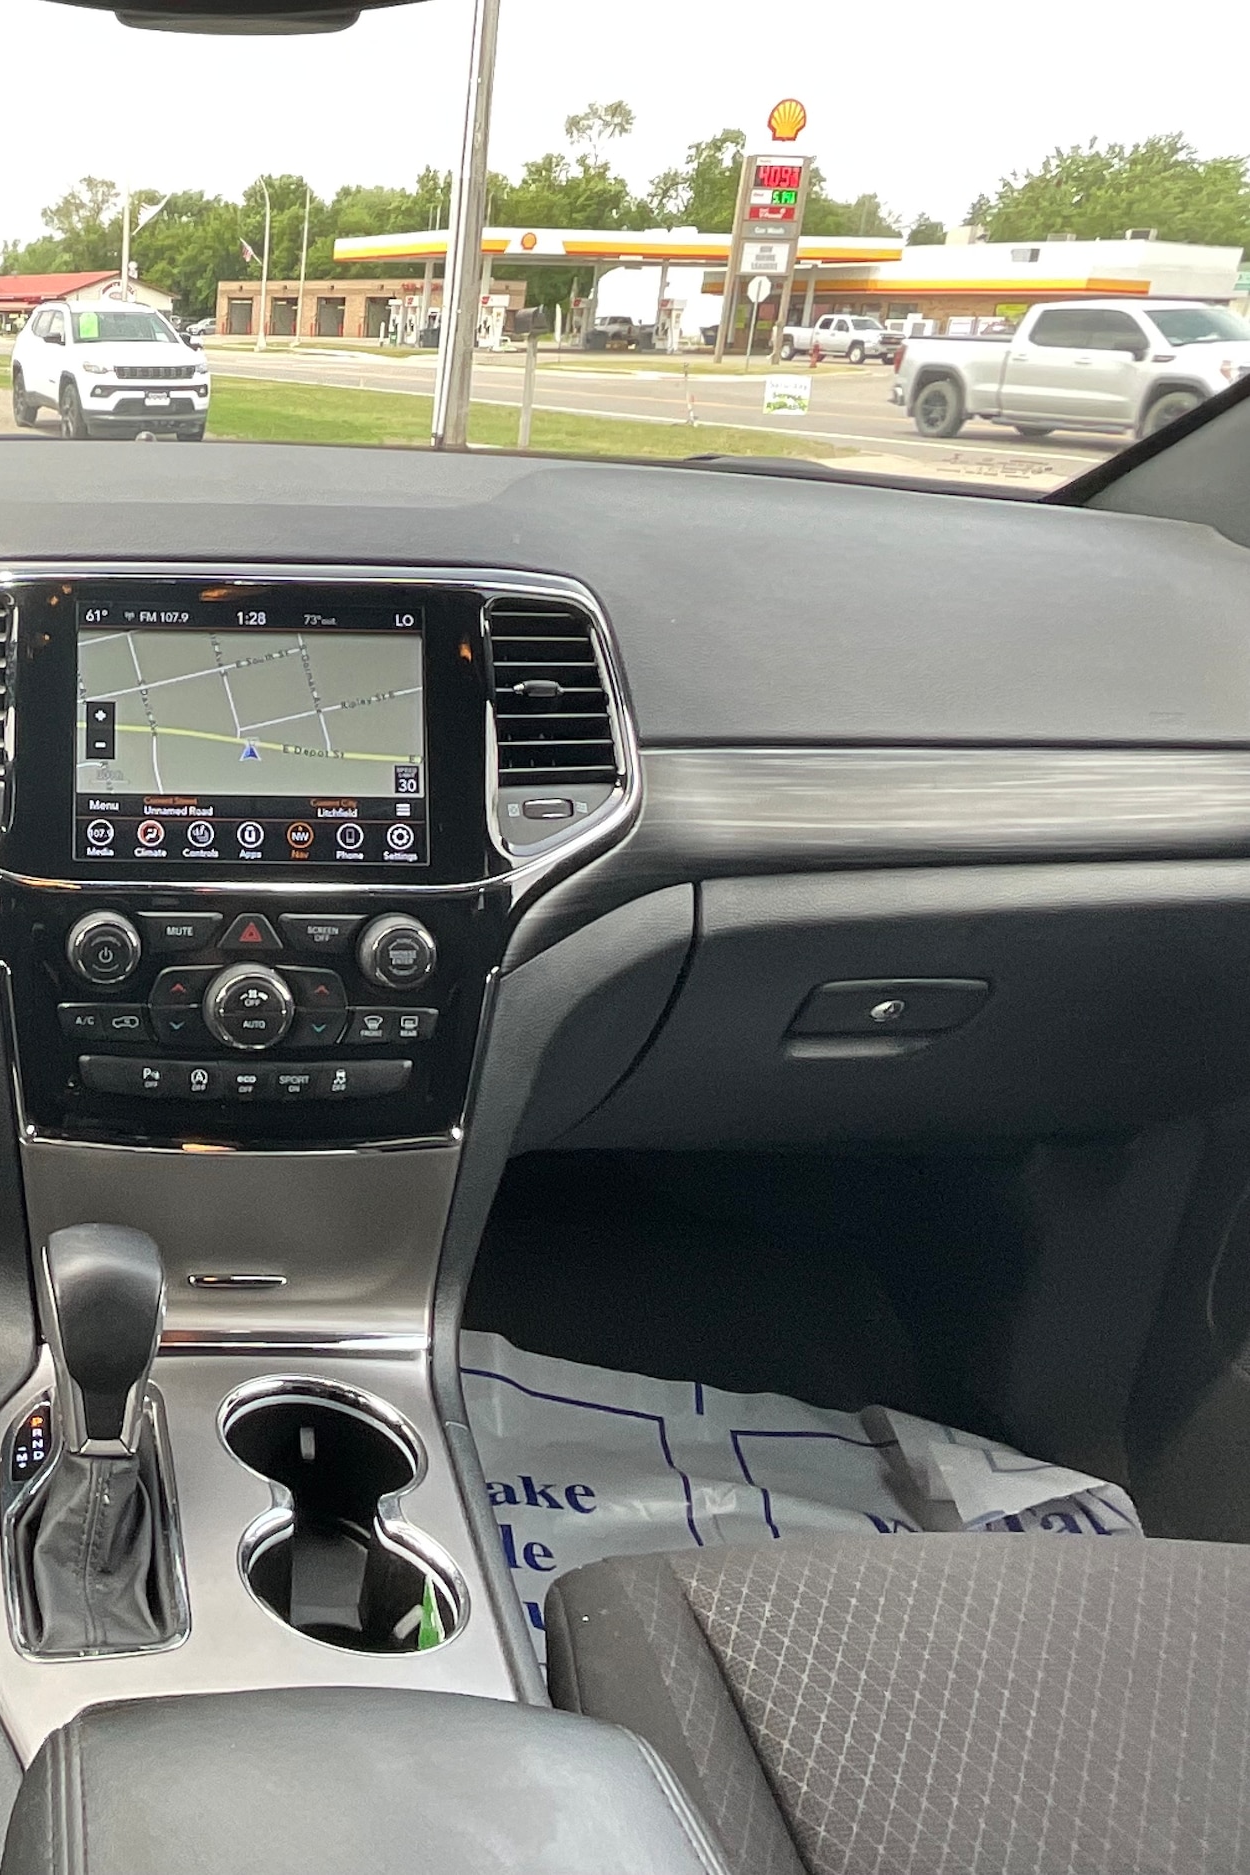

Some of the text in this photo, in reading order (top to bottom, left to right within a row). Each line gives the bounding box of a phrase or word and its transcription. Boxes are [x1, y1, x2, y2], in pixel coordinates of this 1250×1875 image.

[140, 611, 189, 623] FM 107.9
[237, 612, 266, 626] 1:28
[395, 613, 415, 627] LO
[294, 745, 329, 758] Depot
[398, 778, 417, 793] 30
[89, 800, 120, 811] Menu
[143, 806, 214, 817] Unnamed Road
[317, 808, 358, 818] Litchfield
[291, 831, 310, 841] NW
[86, 847, 115, 857] Media
[134, 847, 168, 858] Climate
[182, 848, 220, 858] Controls
[238, 849, 263, 860] Apps
[291, 849, 310, 859] Nav
[336, 850, 365, 860] Phone
[383, 850, 419, 862] Settings
[166, 926, 194, 937] MUTE
[307, 926, 339, 935] SCREEN
[314, 935, 330, 943] OFF
[244, 999, 261, 1007] OFF
[75, 1015, 95, 1026] A/C
[242, 1020, 266, 1029] AUTO
[278, 1075, 310, 1085] SPORT
[238, 1085, 254, 1093] OFF
[288, 1085, 301, 1093] ON
[30, 1415, 44, 1428] P
[32, 1428, 44, 1438] R
[32, 1439, 44, 1449] N
[16, 1453, 28, 1462] M
[33, 1451, 45, 1461] D
[486, 1475, 598, 1514] ake
[498, 1524, 558, 1572] le
